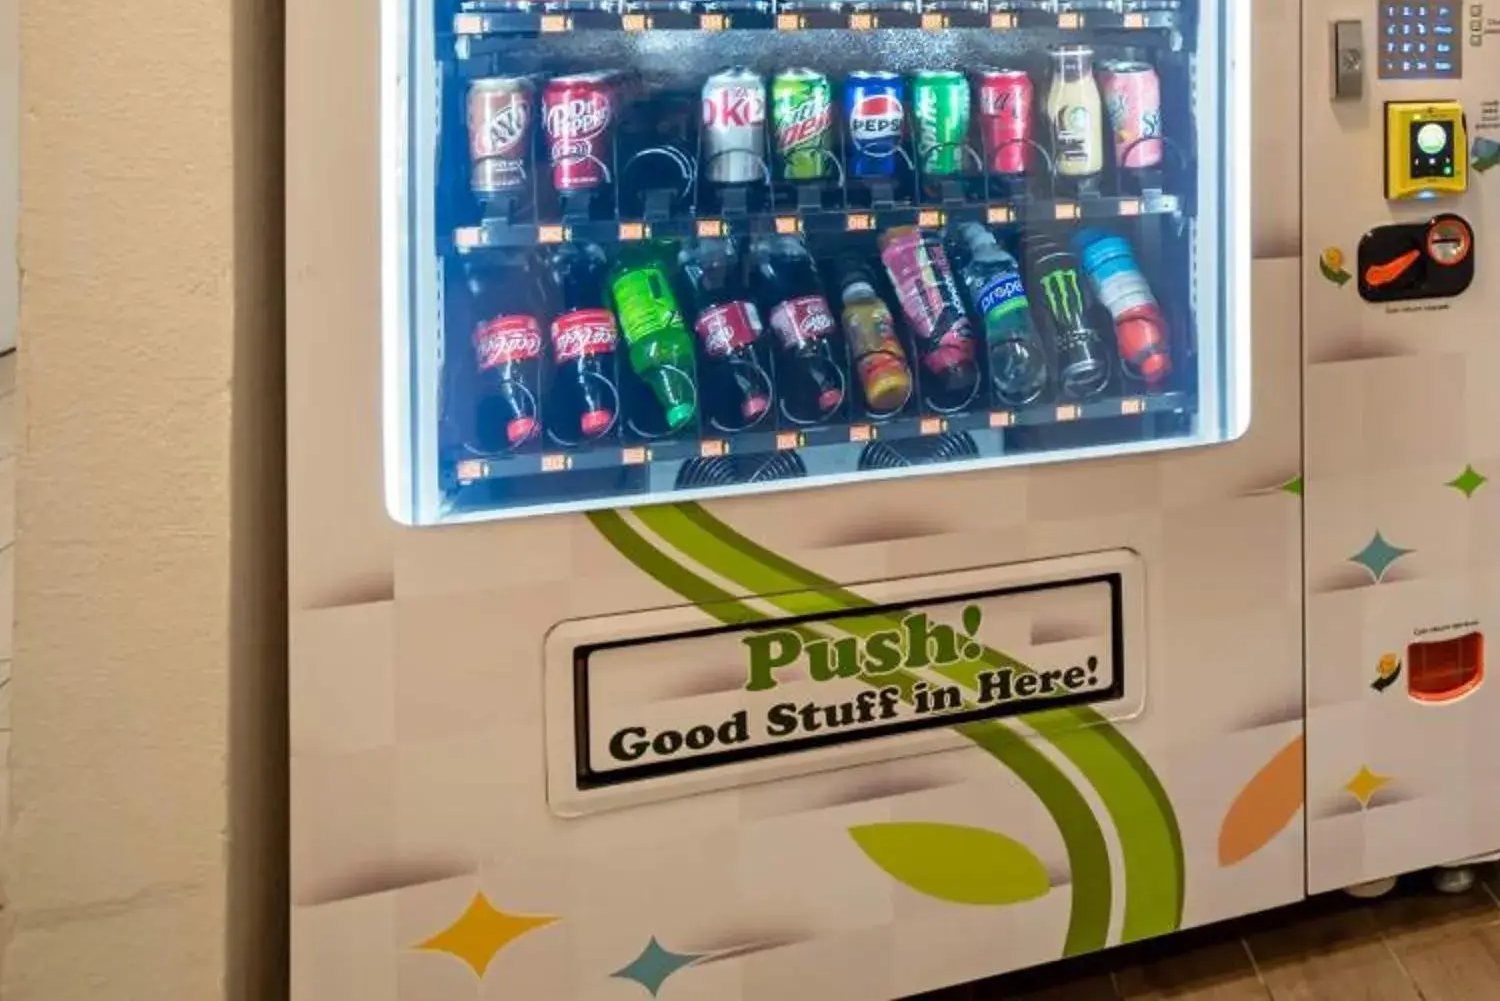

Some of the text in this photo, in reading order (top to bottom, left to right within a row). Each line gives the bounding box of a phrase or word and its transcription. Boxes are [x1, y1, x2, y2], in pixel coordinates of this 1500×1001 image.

[741, 604, 984, 693] Push!
[609, 656, 1100, 764] Good Stuff in Here!
